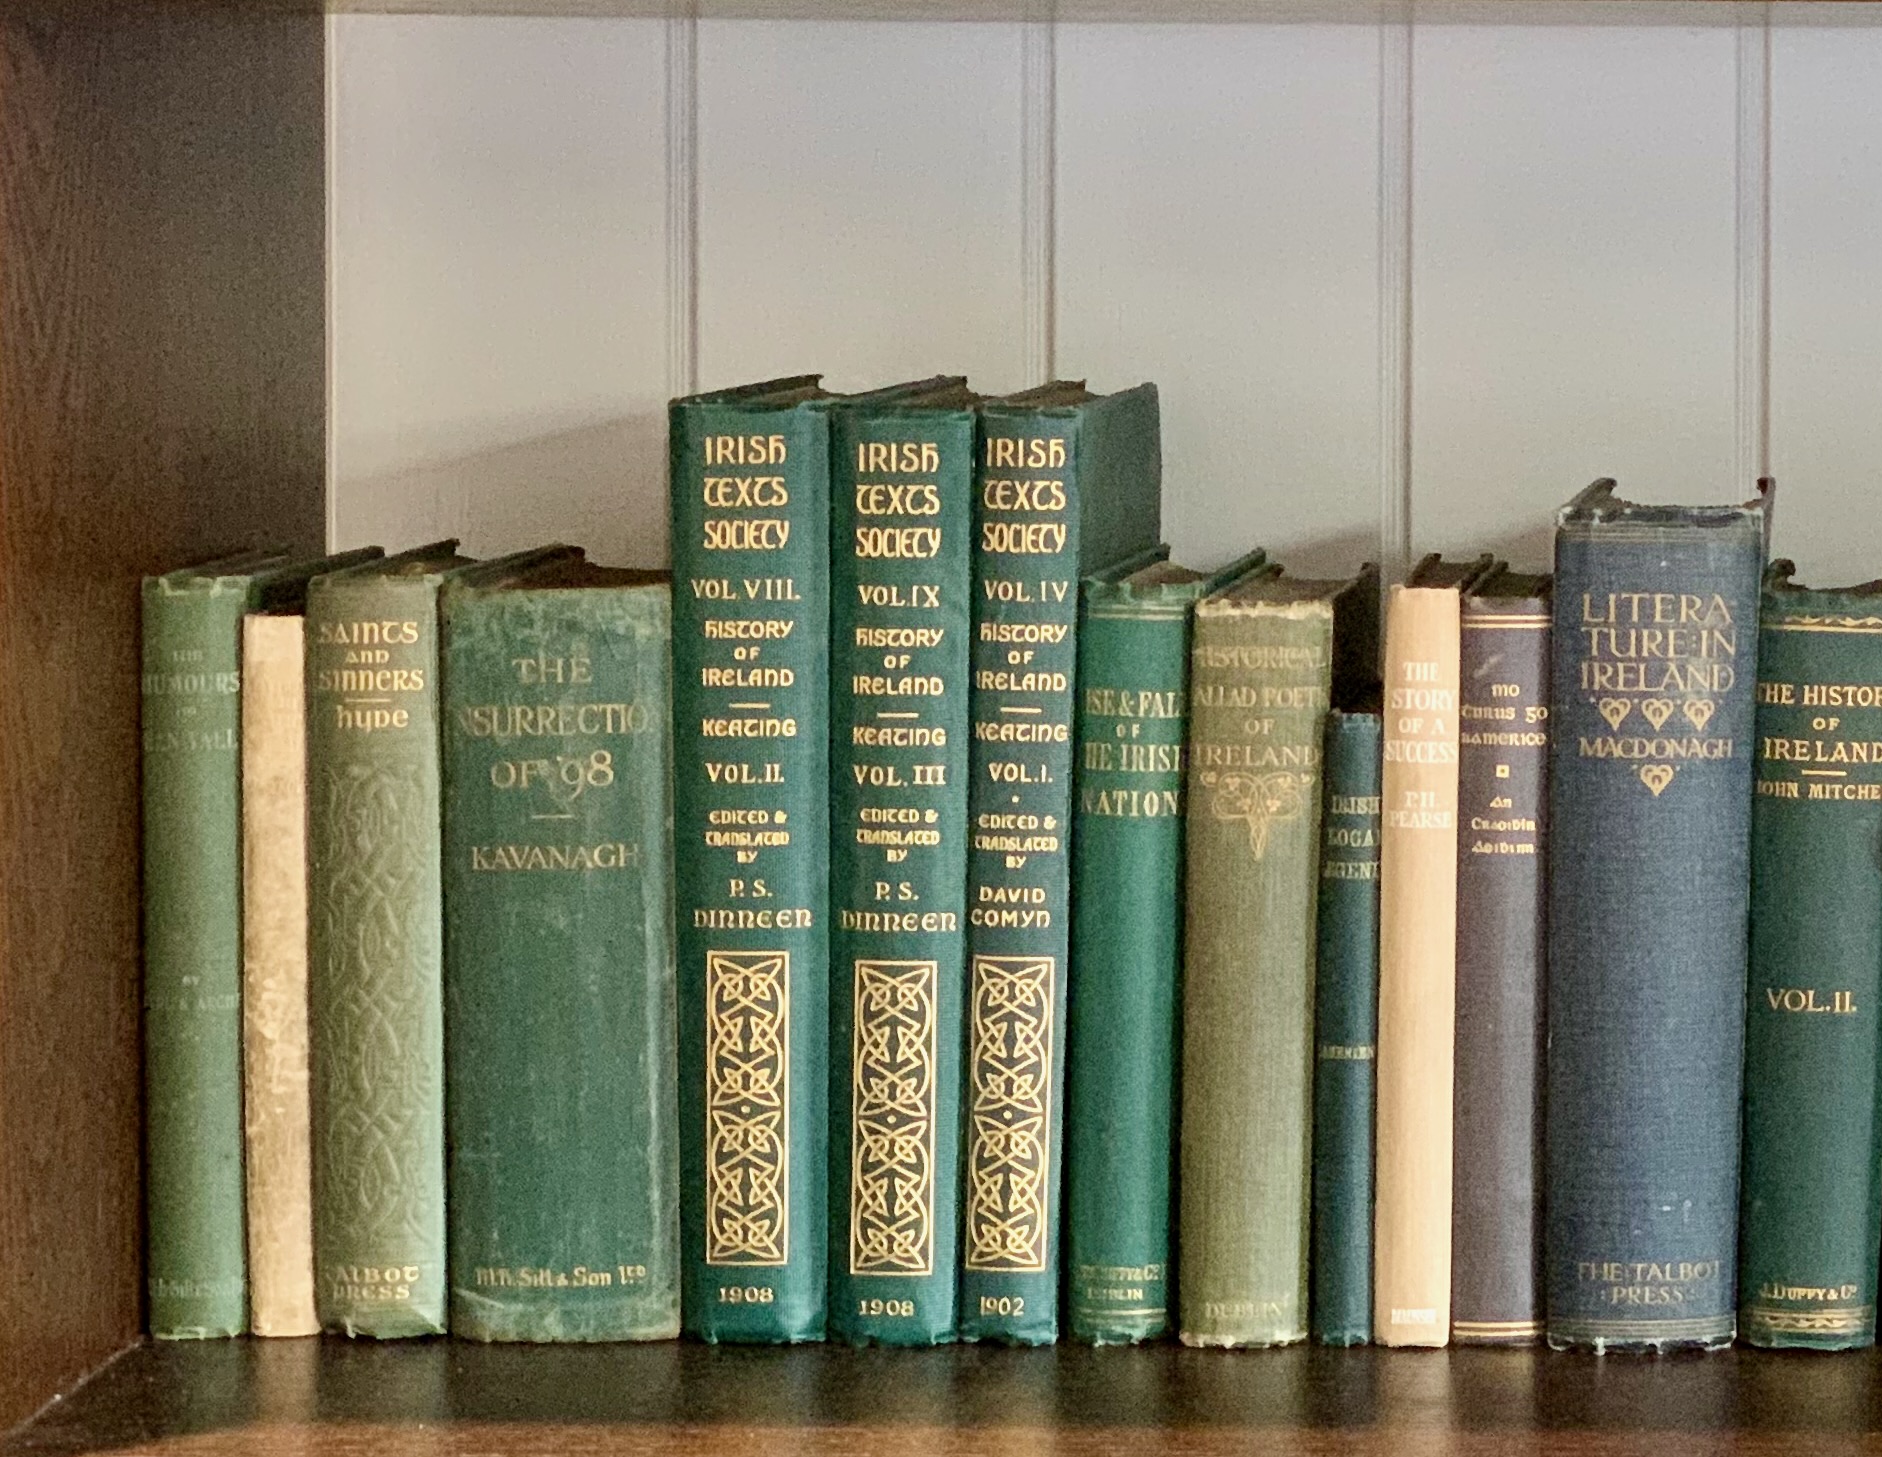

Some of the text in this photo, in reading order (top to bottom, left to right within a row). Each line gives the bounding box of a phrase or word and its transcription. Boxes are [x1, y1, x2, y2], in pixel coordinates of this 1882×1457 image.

[705, 435, 787, 465] IRISH
[858, 442, 939, 473] IRISH
[986, 437, 1065, 469] IRISH
[703, 476, 788, 508] TEXTS
[855, 484, 941, 515] TEXTS
[983, 480, 1066, 511] TEXTS
[703, 519, 790, 550] SOCIETY
[855, 527, 942, 558] SOCIETY
[981, 522, 1067, 554] SOCIETY
[1580, 592, 1736, 624] LITERA
[705, 620, 794, 639] HISTORY
[855, 628, 944, 647] HISTORY
[980, 623, 1068, 643] HISTORY
[734, 646, 761, 661] OF
[883, 654, 911, 669] OF
[1007, 650, 1035, 665] OF
[512, 657, 592, 684] THE
[702, 667, 795, 687] IRELAND
[1402, 661, 1439, 682] THE
[1580, 660, 1736, 692] IRELAND
[853, 675, 944, 695] IRELAND
[976, 671, 1067, 692] IRELAND
[1137, 691, 1181, 718] FAL
[1390, 687, 1457, 712] STORY
[702, 718, 797, 738] KEATING
[975, 723, 1068, 743] KEATING
[1115, 723, 1140, 738] OF
[1244, 718, 1275, 735] OF
[1398, 717, 1446, 736] OF A
[1812, 717, 1840, 731] OF
[852, 727, 947, 747] KEATING
[1085, 742, 1112, 770] HE
[1195, 743, 1320, 767] IRELAND
[1384, 739, 1458, 764] SUCCESS
[1578, 736, 1733, 759] MACDONAGH
[490, 759, 548, 789] OF
[709, 810, 787, 825] EDITED &
[860, 809, 939, 824] EDITED &
[978, 814, 1057, 830] EDITED &
[1389, 811, 1452, 829] PEARSE
[705, 831, 790, 846] TRANSLATED
[856, 830, 940, 846] TRANSLATED
[974, 836, 1058, 852] TRANSLATED
[472, 843, 639, 870] KAVANAGH
[736, 849, 758, 864] BY
[886, 849, 908, 863] BY
[1005, 855, 1027, 869] BY
[979, 886, 1046, 902] DAVID
[694, 908, 812, 929] DINNEEN
[841, 911, 957, 933] DINNEEN
[970, 908, 1051, 928] COMYN
[326, 1265, 419, 1283] ALBOT
[1577, 1260, 1721, 1282] THE TALBOT
[718, 1286, 774, 1304] 1908
[1610, 1286, 1685, 1305] PRESS
[859, 1299, 915, 1317] 1908
[979, 1296, 1025, 1317] 1902
